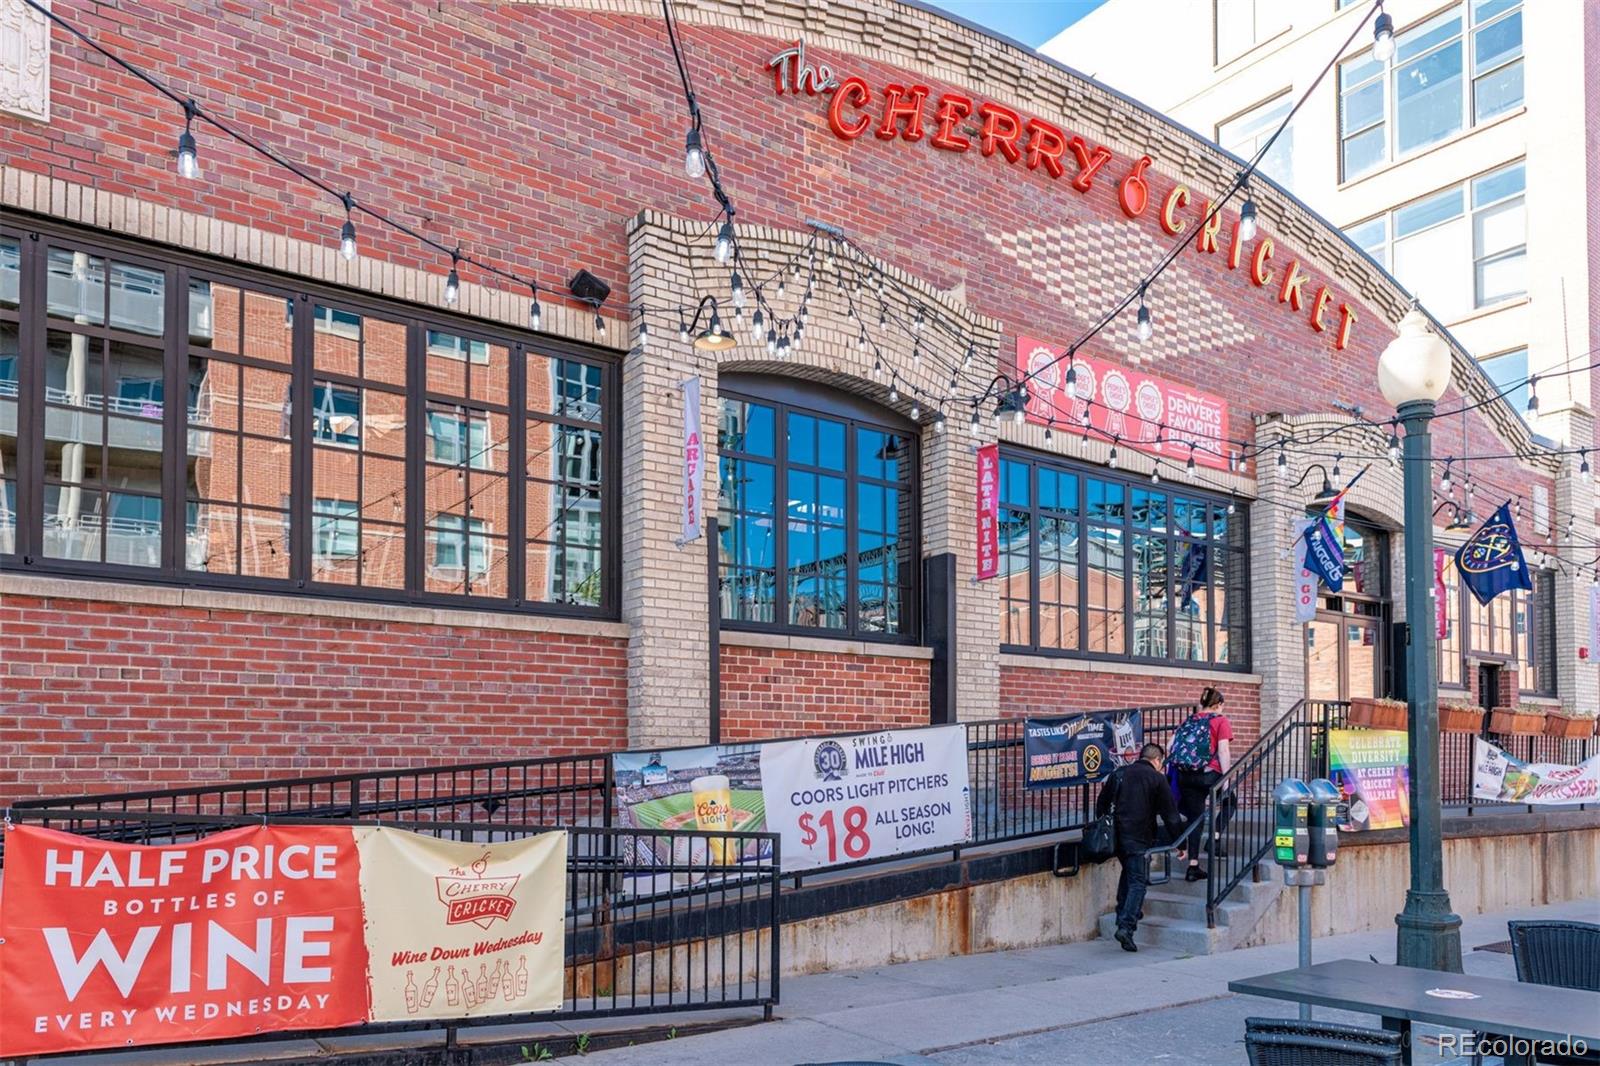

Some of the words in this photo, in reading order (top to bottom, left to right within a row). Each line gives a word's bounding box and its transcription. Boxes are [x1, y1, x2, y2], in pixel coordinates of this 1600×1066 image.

[764, 39, 841, 97] The
[827, 75, 1111, 194] CHERRY
[1158, 183, 1360, 352] CRICKET
[1168, 396, 1221, 424] DENVER'S
[1168, 412, 1221, 439] FAVORITE
[1029, 727, 1050, 737] TASTES
[1087, 723, 1104, 732] TIME
[852, 735, 886, 748] SWING
[1349, 735, 1401, 749] CELEBRATE
[820, 750, 841, 770] 30
[855, 745, 888, 770] MILE
[890, 742, 925, 765] HIGH
[1352, 750, 1399, 763] DIVERSITY
[1357, 767, 1366, 777] AT
[1367, 767, 1395, 777] CHERRY
[790, 786, 844, 807] COORS
[847, 781, 885, 799] LIGHT
[888, 773, 949, 795] PITCHERS
[1362, 779, 1392, 789] CRICKET
[697, 802, 729, 817] Coors
[701, 814, 727, 825] LIGHT
[875, 811, 898, 826] ALL
[901, 802, 952, 822] SEASON
[798, 805, 871, 863] $18
[895, 821, 936, 840] LONG!
[45, 848, 189, 888] HALF
[201, 844, 338, 884] PRICE
[449, 866, 466, 876] The
[445, 882, 508, 897] CHERRY
[103, 891, 236, 916] BOTTLES
[253, 890, 286, 906] OF
[453, 899, 511, 918] CRICKET
[392, 951, 427, 967] Wine
[430, 946, 471, 962] Down
[473, 930, 544, 957] Wednesday
[42, 916, 335, 1002] WINE
[34, 1008, 138, 1033] EVERY
[155, 994, 330, 1023] WEDNESDAY
